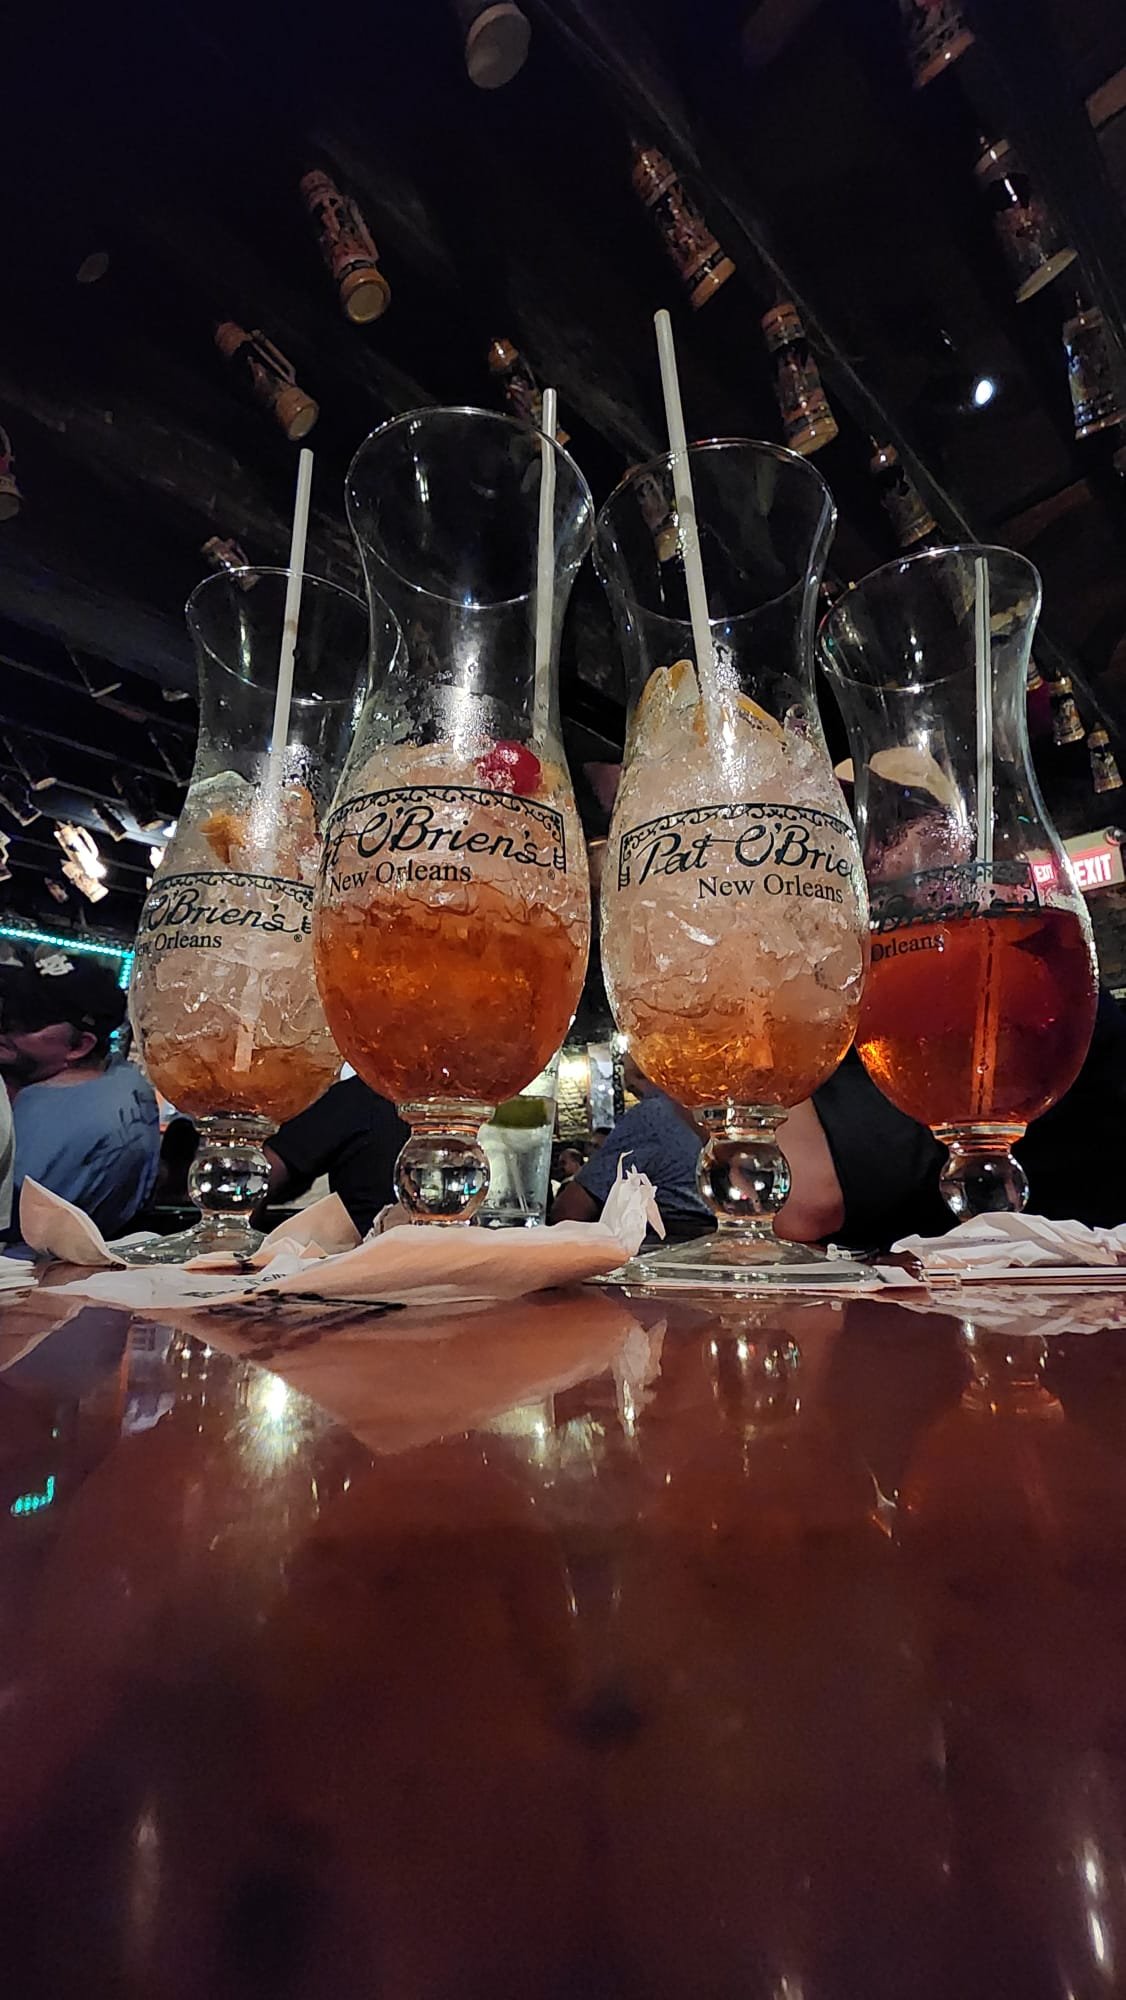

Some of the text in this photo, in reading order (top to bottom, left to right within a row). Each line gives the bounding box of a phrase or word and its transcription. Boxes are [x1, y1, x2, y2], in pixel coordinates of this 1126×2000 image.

[356, 805, 551, 868] O'Brien's
[636, 832, 713, 885] Pat
[1073, 852, 1112, 887] EXIT
[330, 859, 472, 897] New Orleans
[698, 873, 844, 904] New Orleans
[154, 930, 223, 951] Orleans
